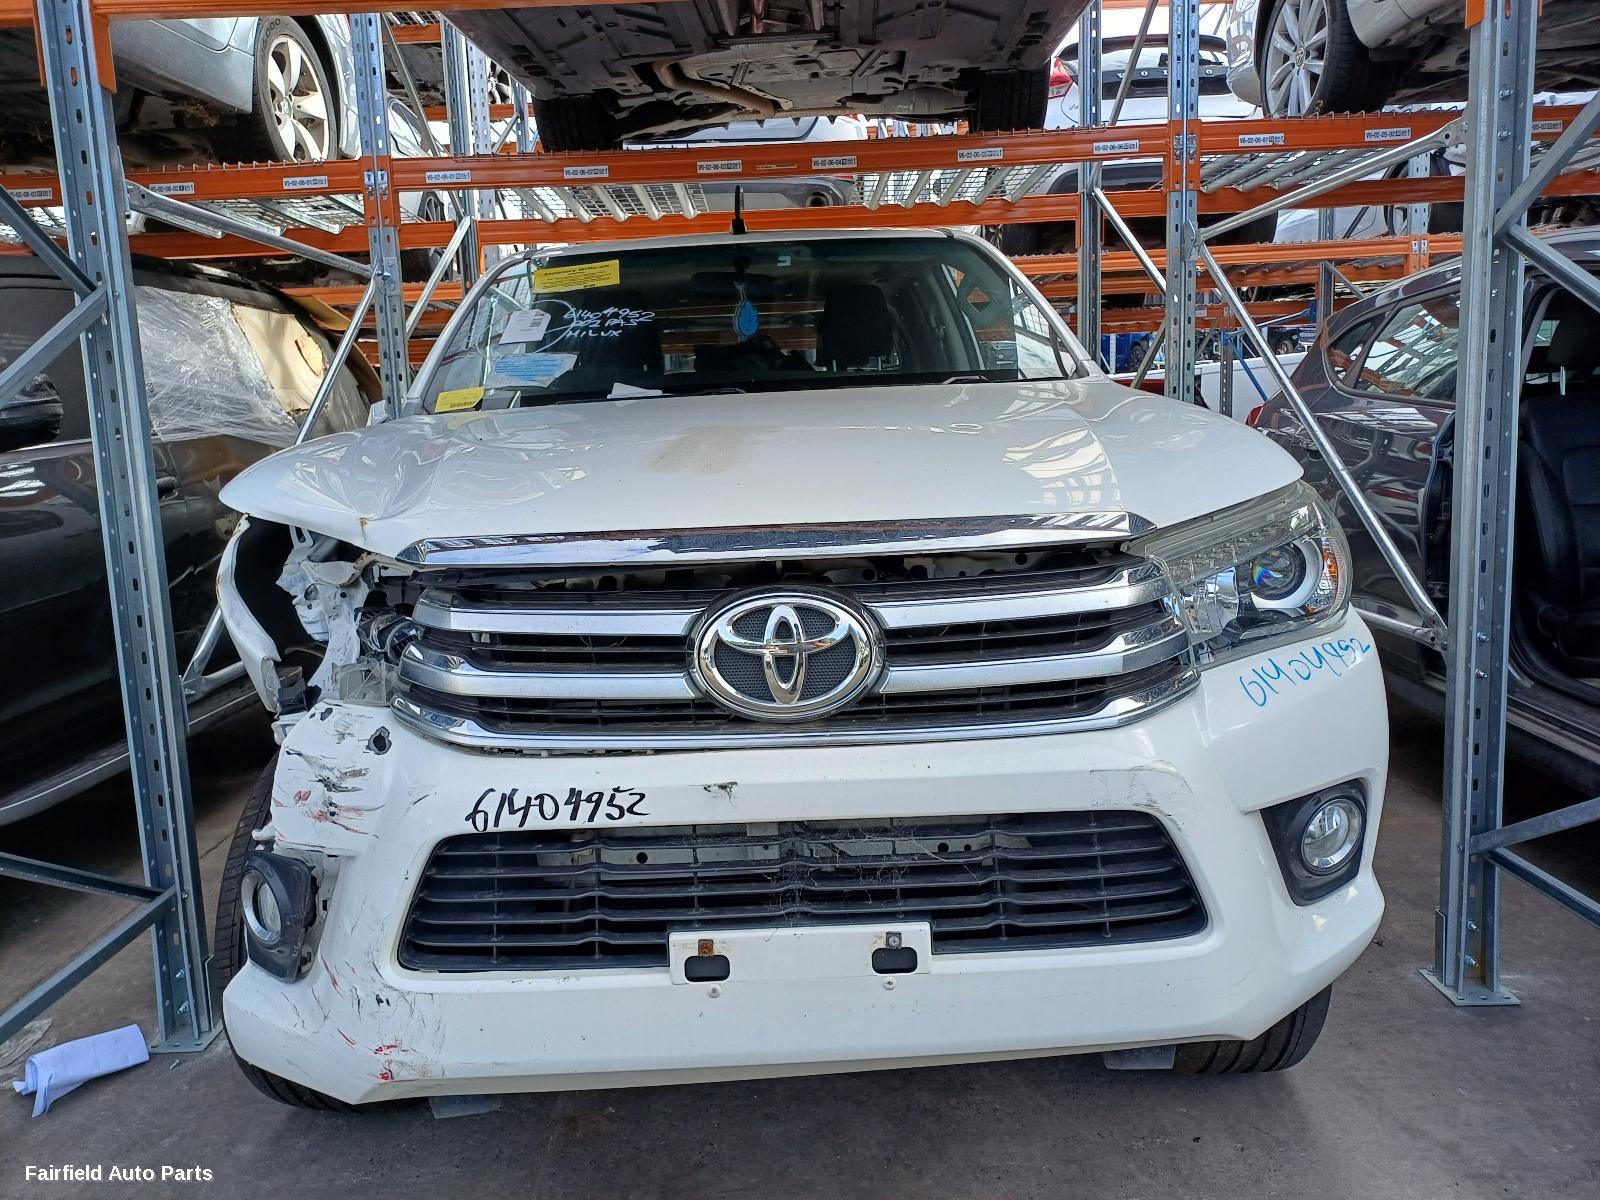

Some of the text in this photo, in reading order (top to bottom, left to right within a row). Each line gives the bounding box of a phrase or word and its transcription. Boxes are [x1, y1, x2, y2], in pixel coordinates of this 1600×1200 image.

[1116, 69, 1213, 79] VOLO
[566, 329, 623, 339] HILUX
[1239, 637, 1371, 708] 61404952
[464, 785, 650, 833] 61404952
